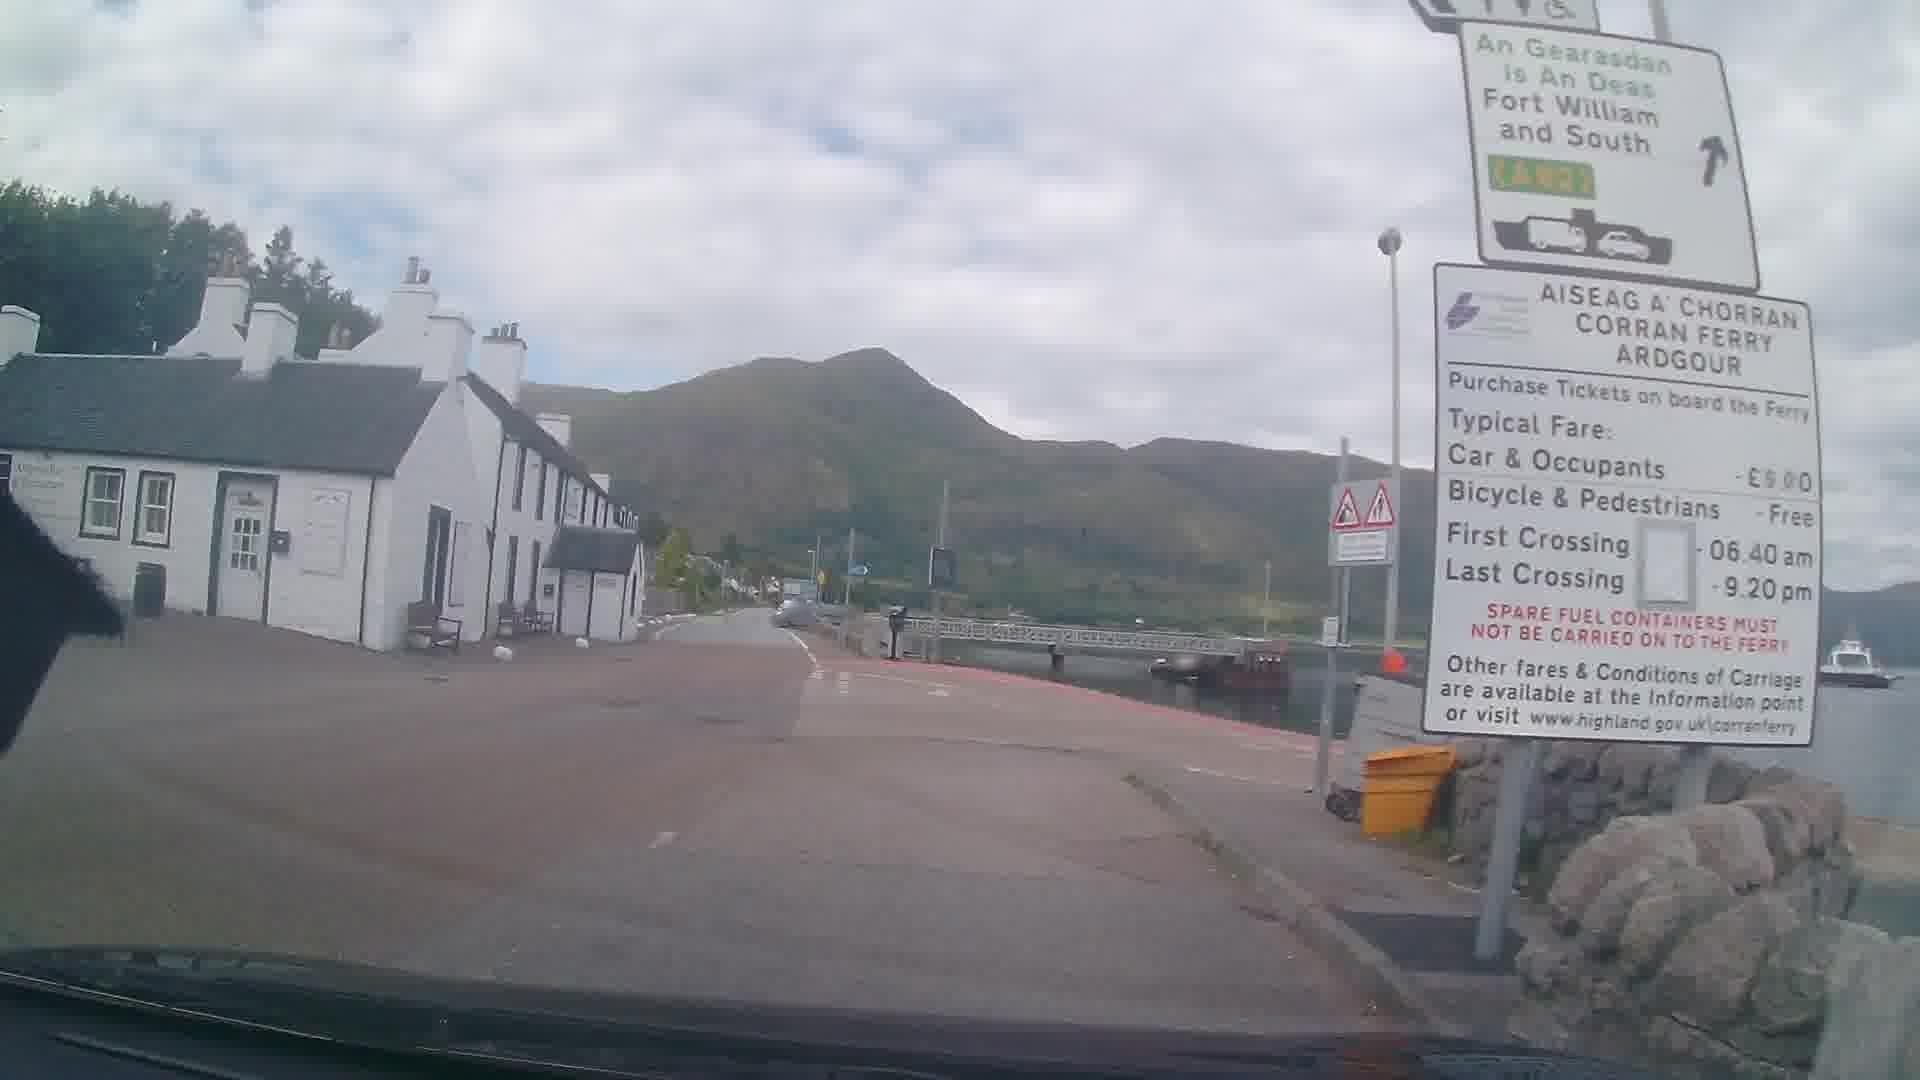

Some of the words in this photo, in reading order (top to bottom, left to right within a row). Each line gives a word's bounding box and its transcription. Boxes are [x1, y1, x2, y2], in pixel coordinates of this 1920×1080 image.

[1476, 34, 1513, 55] An
[1540, 67, 1576, 89] An
[1589, 71, 1656, 99] Deas
[1483, 88, 1545, 114] Fort
[1555, 95, 1660, 128] William
[1501, 121, 1552, 144] and
[1566, 125, 1651, 154] South
[1540, 284, 1640, 312] AISEAG
[1680, 295, 1799, 330] CHORRAN
[1576, 312, 1688, 343] CORRAN
[1699, 328, 1773, 353] FERRY
[1616, 344, 1742, 376] ARDGOUR
[1449, 371, 1549, 396] Purchase
[1556, 378, 1632, 403] Tickets
[1639, 389, 1664, 406] on
[1670, 389, 1722, 412] board
[1729, 398, 1759, 416] the
[1765, 401, 1810, 424] Ferry
[1449, 407, 1539, 435] Typical
[1448, 443, 1494, 469] Car
[1505, 448, 1522, 470] &
[1533, 449, 1666, 481] Occupants
[1449, 480, 1544, 509] Bicycle
[1553, 486, 1569, 509] &
[1580, 488, 1721, 520] Pedestrians
[1769, 503, 1815, 528] Free
[1447, 522, 1507, 548] First
[1519, 526, 1631, 559] Crossing
[1710, 540, 1778, 566] 06.40
[1784, 550, 1814, 568] am
[1446, 559, 1502, 584] Last
[1513, 562, 1626, 594] Crossing
[1724, 575, 1778, 600] 9.20
[1781, 583, 1813, 607] pm
[1487, 602, 1549, 622] SPARE
[1559, 607, 1605, 626] FUEL
[1611, 609, 1727, 632] CONTAINERS
[1733, 616, 1777, 634] MUST
[1471, 623, 1511, 640] NOT
[1519, 626, 1543, 642] BE
[1551, 627, 1633, 647] CARRIED
[1640, 630, 1666, 648] ON
[1673, 632, 1695, 650] TO
[1700, 635, 1731, 651] THE
[1447, 655, 1507, 676] Other
[1517, 659, 1569, 679] fares
[1575, 661, 1589, 680] &
[1597, 662, 1698, 685] Conditions
[1705, 667, 1724, 686] of
[1730, 668, 1802, 691] Carriage
[1440, 682, 1474, 698] are
[1482, 684, 1576, 703] available
[1583, 688, 1602, 705] at
[1610, 687, 1642, 705] the
[1648, 689, 1754, 710] Information
[1761, 693, 1806, 713] point
[1446, 707, 1469, 722] or
[1477, 705, 1519, 725] visit
